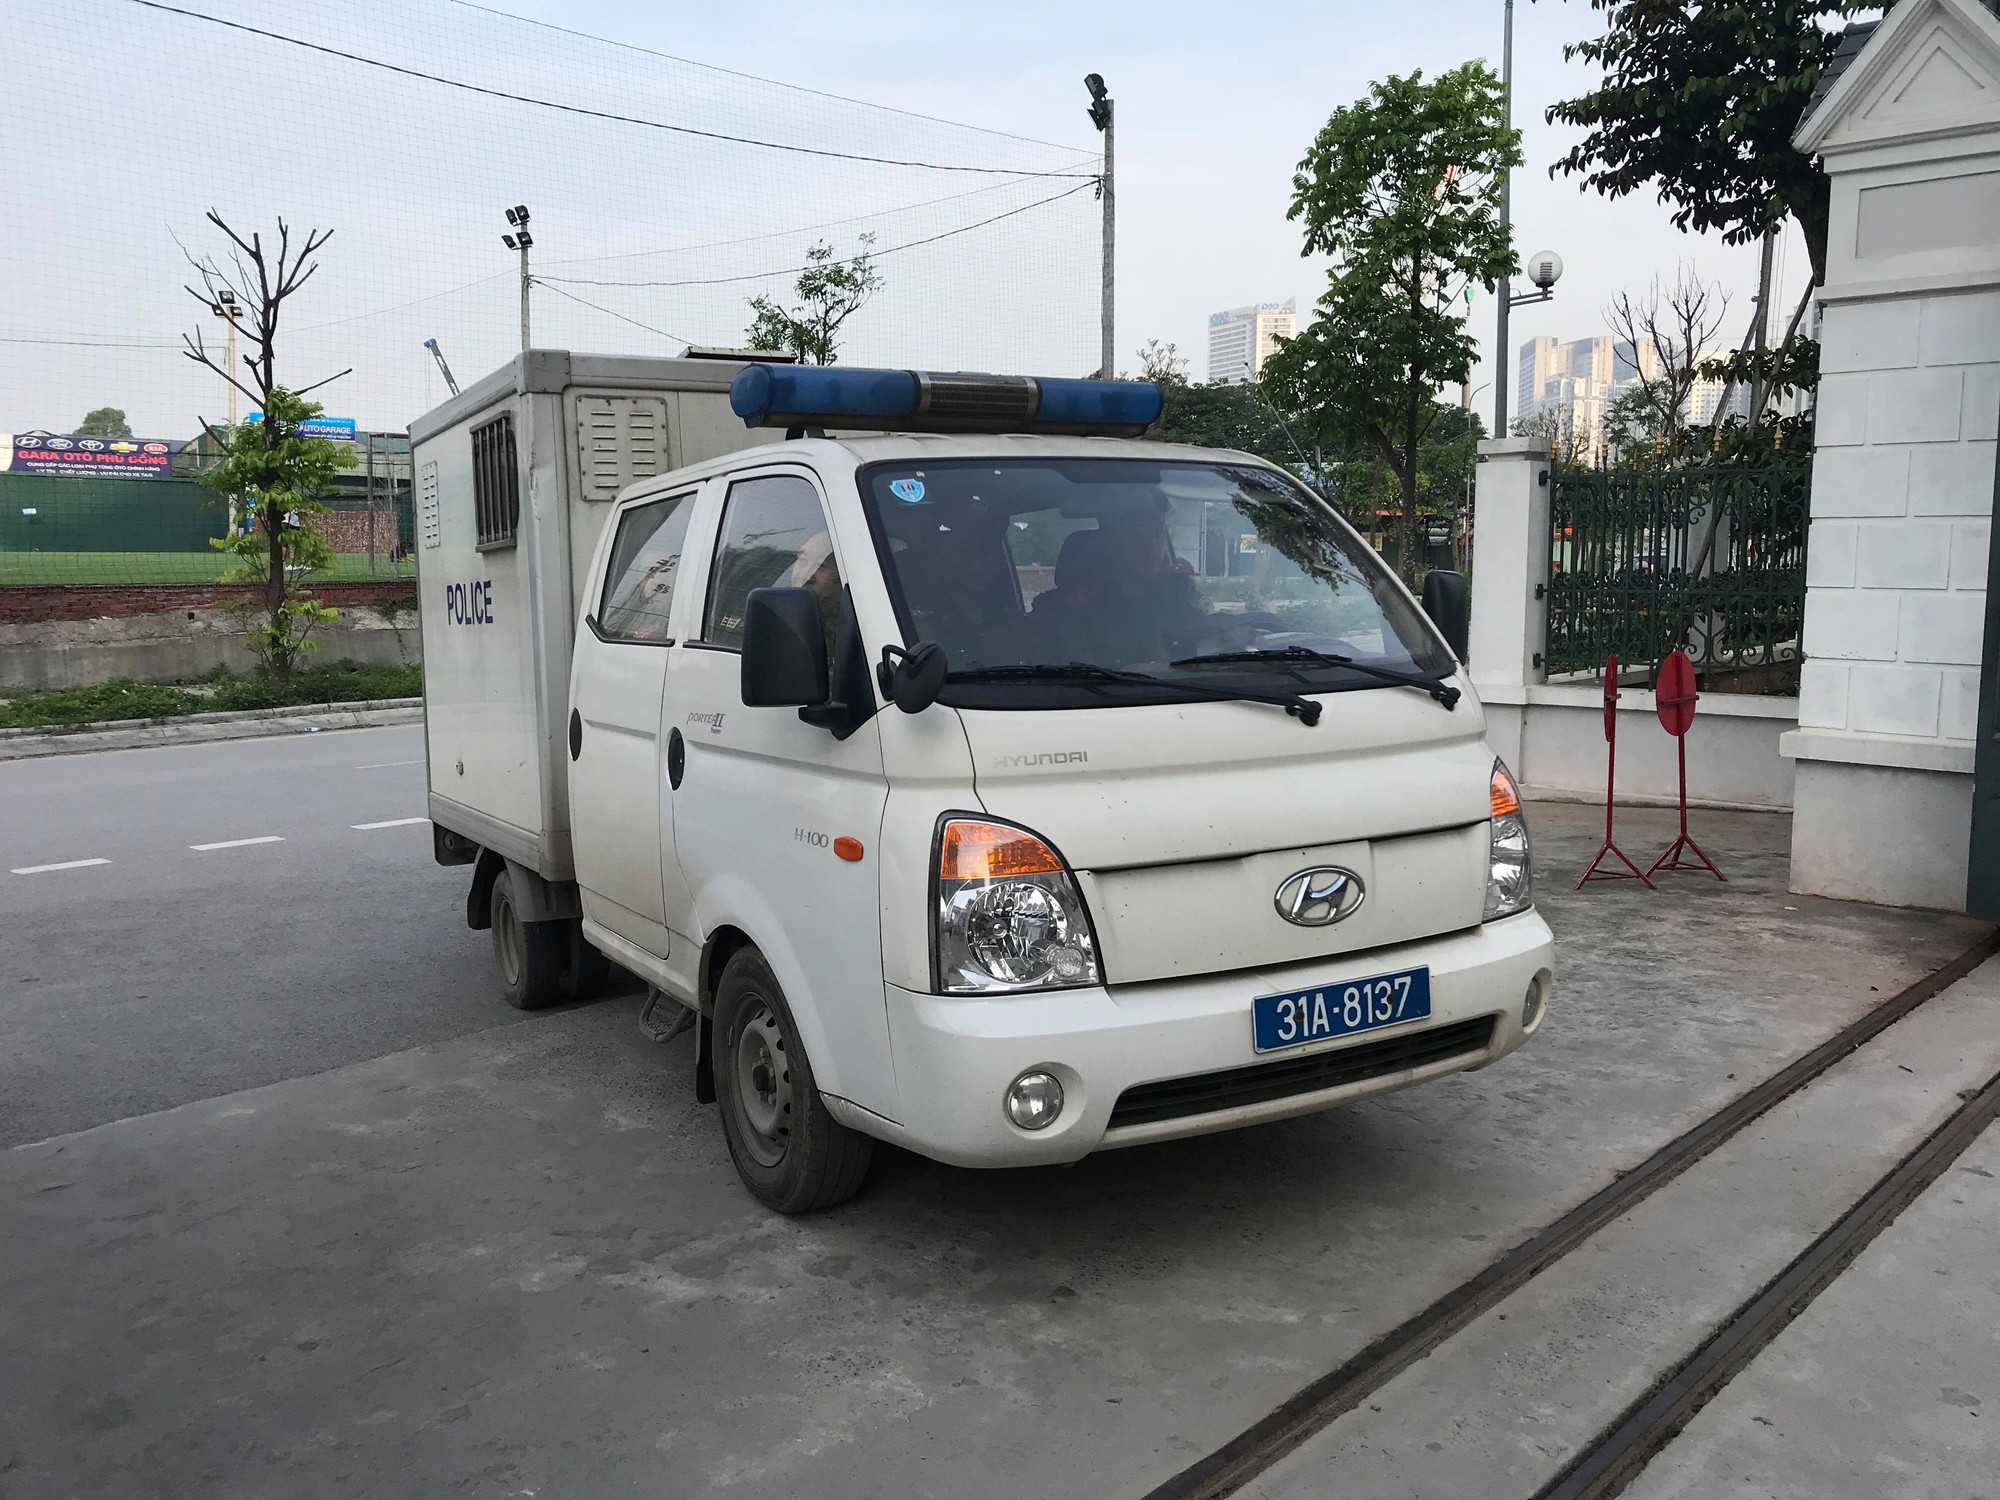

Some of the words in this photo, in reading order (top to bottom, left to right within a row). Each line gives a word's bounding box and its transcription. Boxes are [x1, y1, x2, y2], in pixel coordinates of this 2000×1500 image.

[299, 425, 319, 433] AUTO
[320, 425, 352, 434] GARAGE
[17, 450, 60, 460] GARA
[63, 451, 92, 462] OTÔ
[446, 580, 493, 626] POLICE
[992, 751, 1088, 768] HYUNDAI
[794, 827, 829, 848] H-100
[1276, 975, 1412, 1041] 31A-8137
